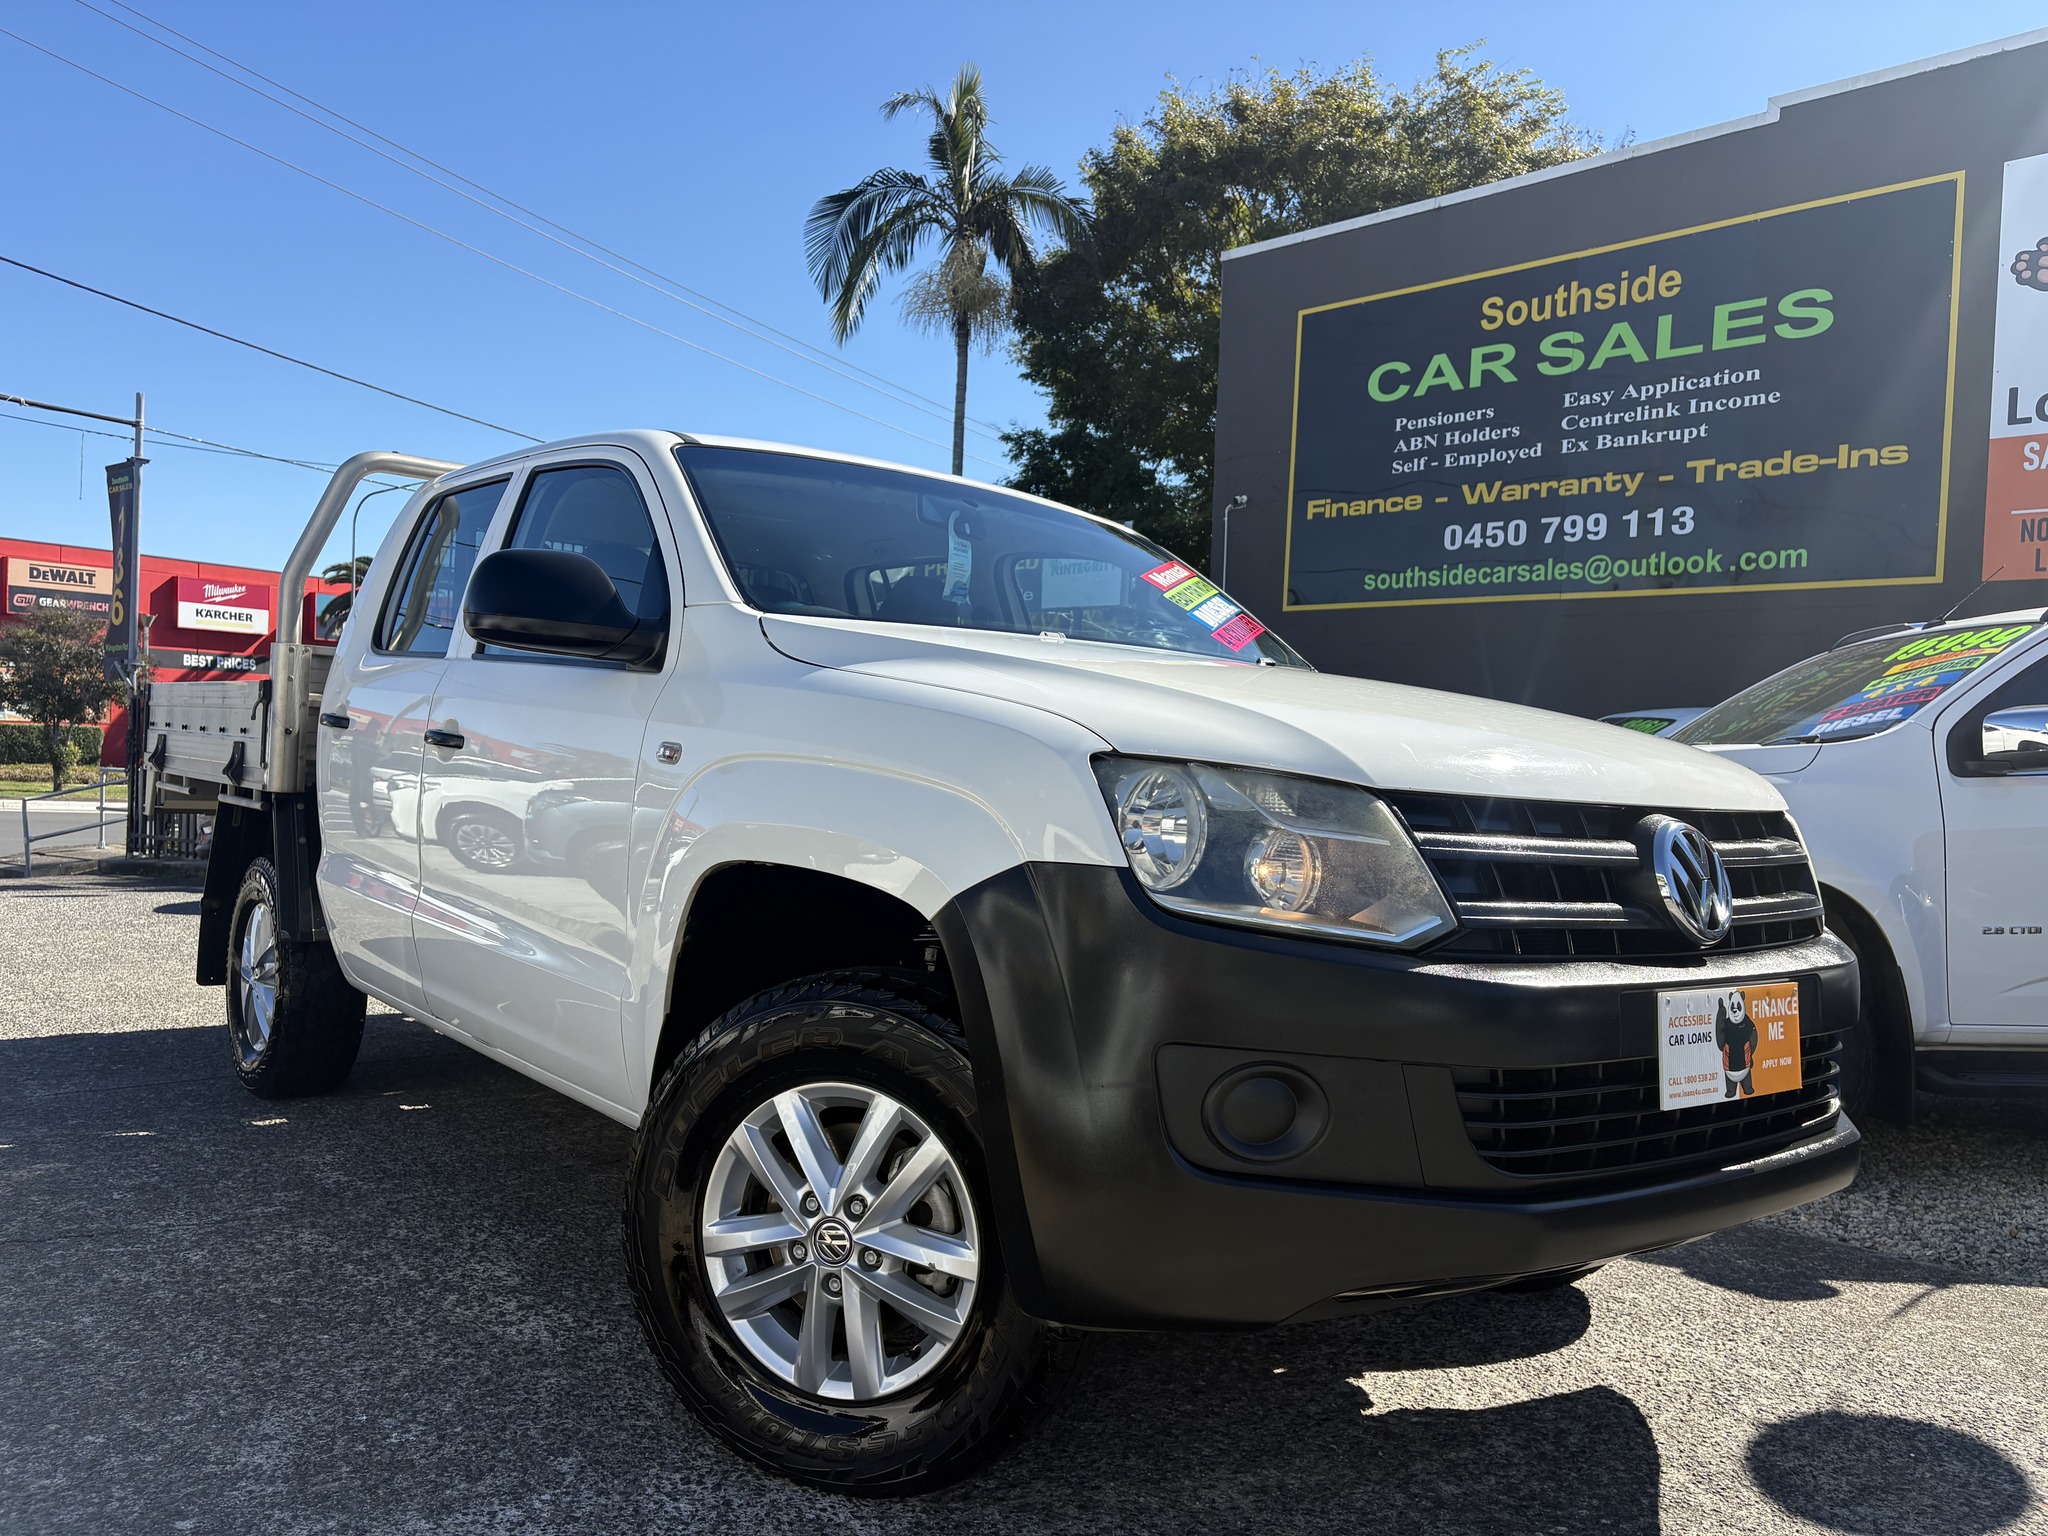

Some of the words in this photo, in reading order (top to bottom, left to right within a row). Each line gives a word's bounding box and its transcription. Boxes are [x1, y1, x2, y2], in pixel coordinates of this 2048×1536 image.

[1480, 264, 1682, 331] Southside
[1367, 342, 1519, 403] CAR
[1536, 288, 1835, 377] SALES
[1562, 390, 1615, 408] Easy
[1621, 367, 1761, 400] Application
[1394, 406, 1495, 432] Pensioners
[1560, 403, 1681, 431] Centrelink
[1688, 391, 1782, 415] Income
[1393, 434, 1439, 453] ABN
[1444, 425, 1521, 446] Holders
[1560, 437, 1589, 454] Ex
[1595, 422, 1709, 450] Bankrupt
[1391, 456, 1428, 475] Self
[1443, 442, 1543, 468] Employed
[1306, 494, 1423, 521] Finance
[1462, 472, 1645, 506] Warranty
[1686, 443, 1909, 484] Trade-Ins
[1443, 519, 1527, 551] 0450
[1540, 512, 1608, 544] 799
[1622, 505, 1696, 539] 113
[202, 583, 247, 599] Milwaukee
[195, 607, 253, 623] KÄRCHER
[1192, 596, 1237, 630] DIESEL
[183, 653, 214, 668] BEST
[216, 656, 257, 671] PRICES
[1809, 706, 1903, 736] DIESEL
[1668, 1014, 1712, 1028] ACCESSIBLE
[1752, 997, 1797, 1019] FINANCE
[1669, 1035, 1685, 1046] CAR
[1688, 1032, 1712, 1044] LOANS
[1768, 1021, 1784, 1041] ME
[1762, 1058, 1778, 1069] APPLY
[1779, 1056, 1792, 1066] NOW
[1668, 1076, 1683, 1086] CALL
[1684, 1074, 1697, 1084] 1800
[1698, 1073, 1708, 1083] 538
[1708, 1072, 1718, 1081] 287
